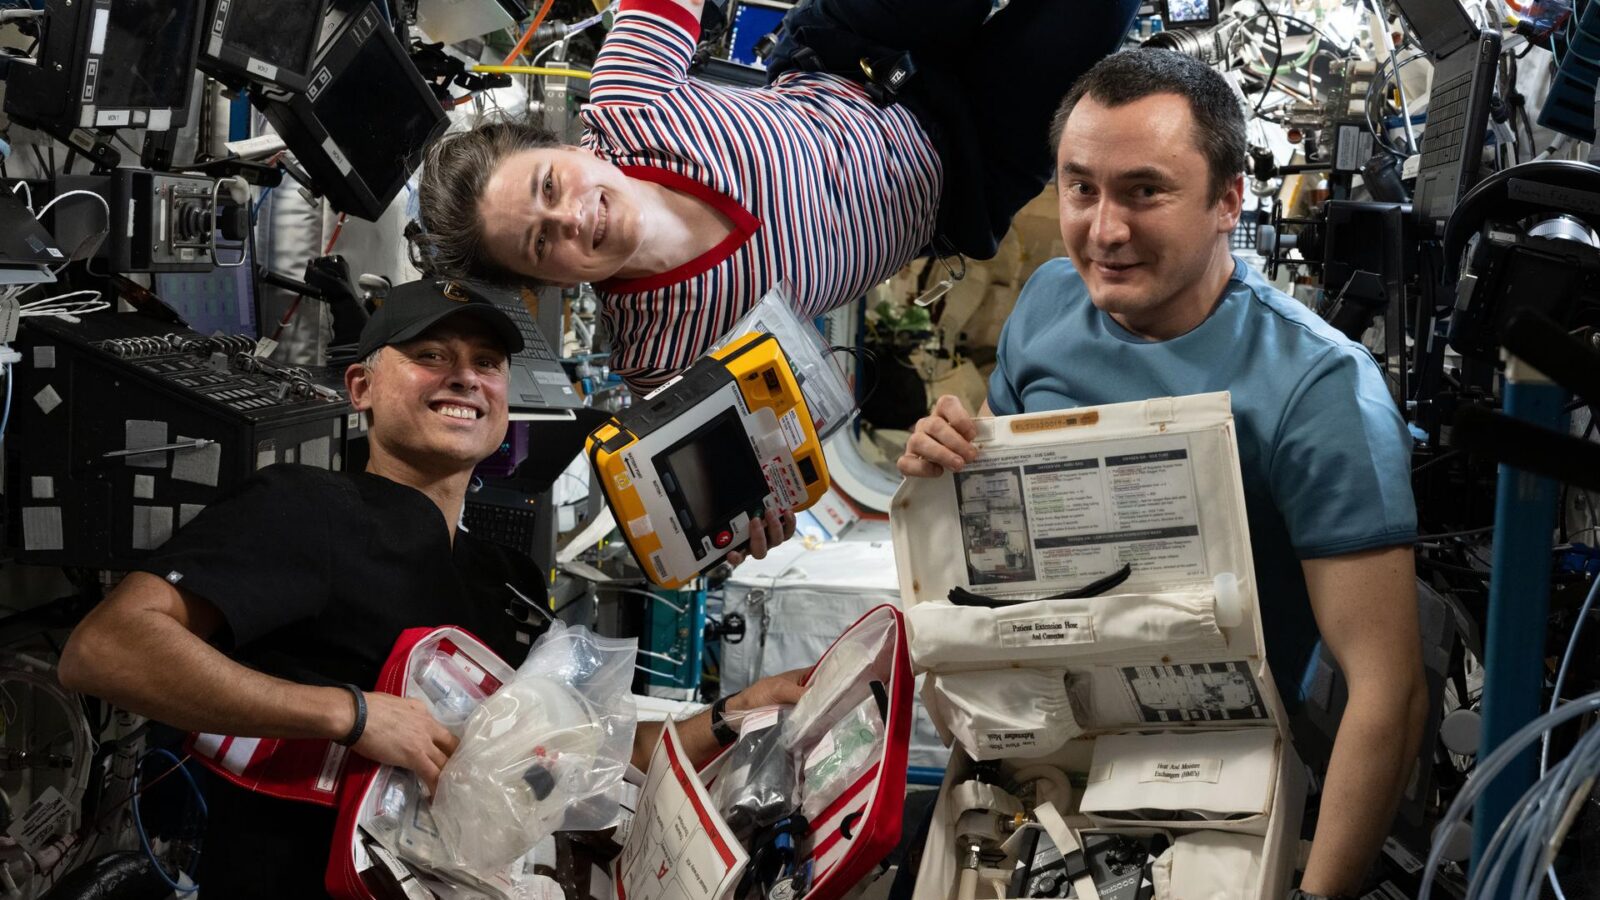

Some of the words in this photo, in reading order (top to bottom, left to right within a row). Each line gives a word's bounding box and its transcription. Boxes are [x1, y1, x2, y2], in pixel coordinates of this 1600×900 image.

[627, 452, 638, 468] BATTERY
[634, 468, 643, 479] PORT
[1012, 623, 1032, 632] Patient
[1034, 622, 1062, 630] Extension
[1064, 620, 1078, 629] Hose
[1042, 631, 1064, 639] Connector
[987, 733, 1001, 742] Mask
[1154, 769, 1179, 779] Exchangers
[657, 860, 669, 880] A
